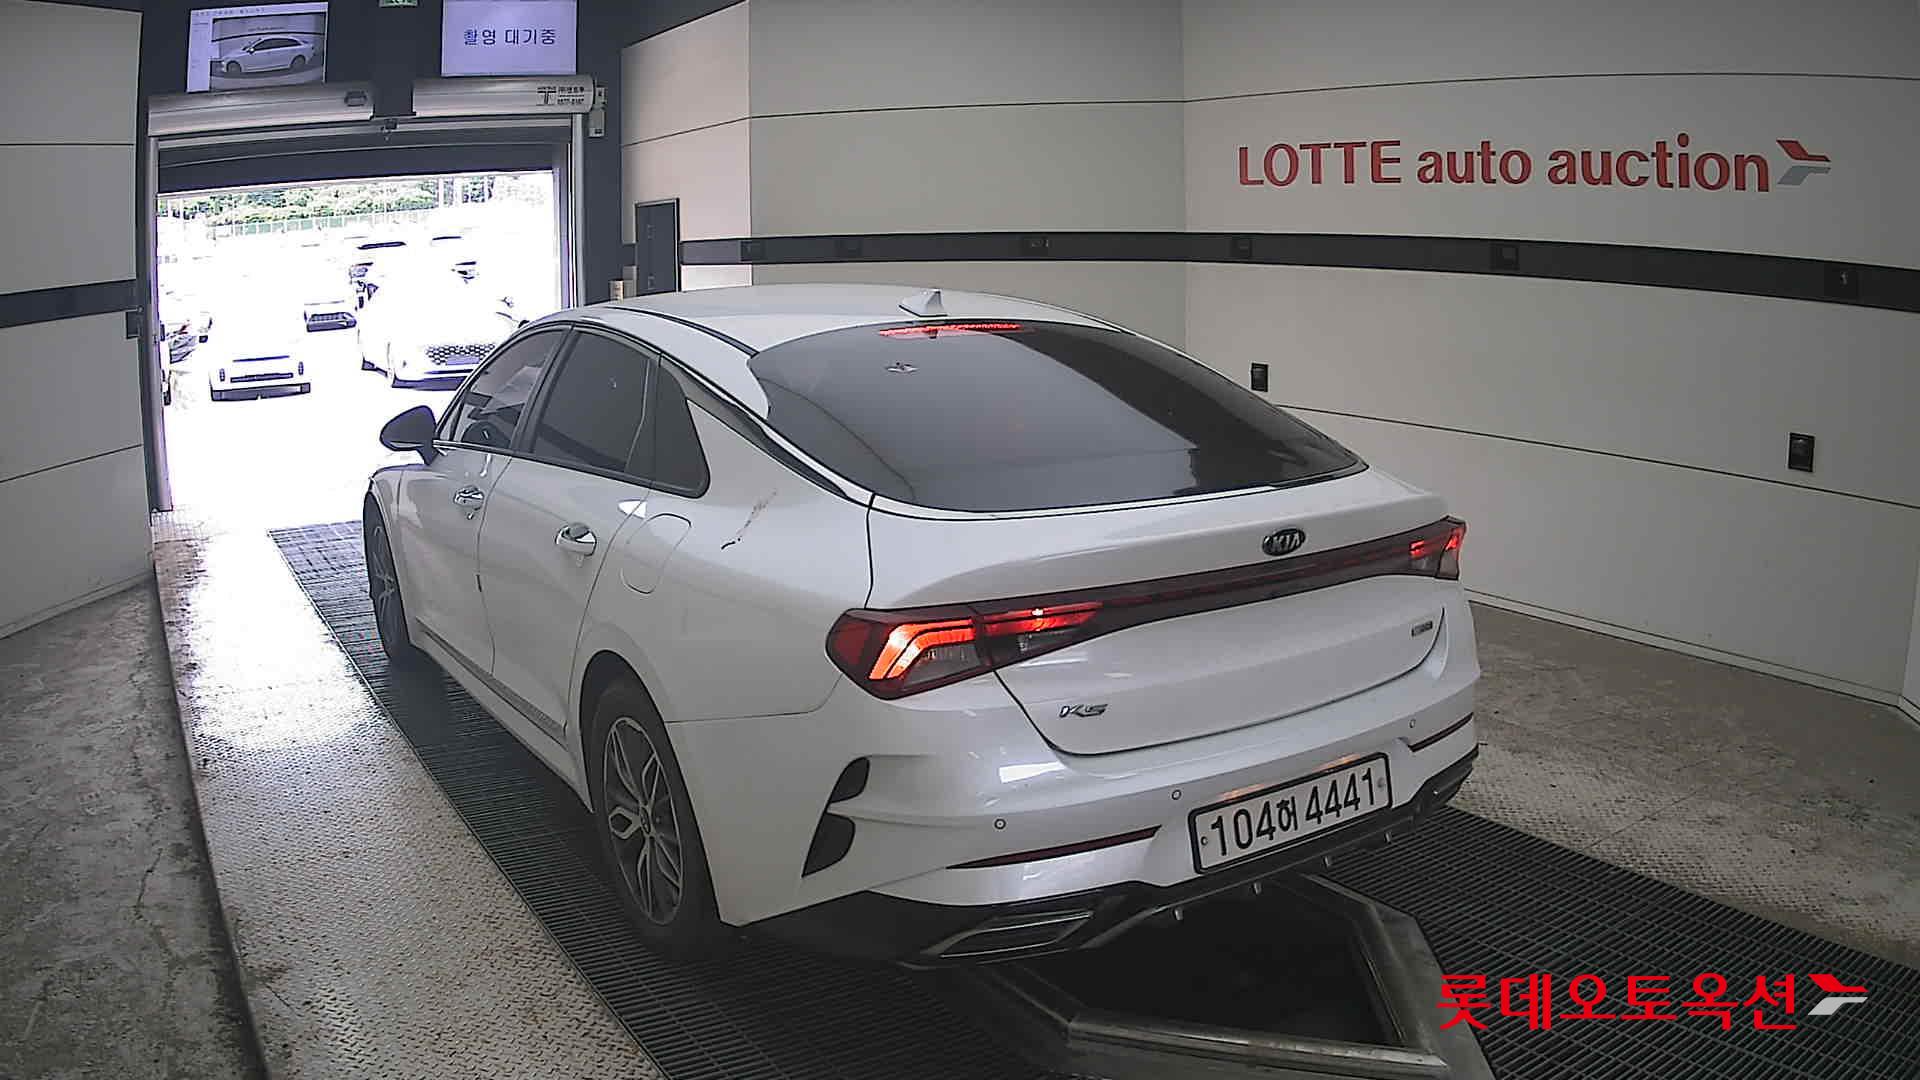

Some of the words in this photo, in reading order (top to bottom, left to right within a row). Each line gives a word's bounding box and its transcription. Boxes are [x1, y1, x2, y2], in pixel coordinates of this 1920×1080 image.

[464, 28, 496, 46] 촬영
[504, 28, 556, 46] 대기중
[1238, 140, 1402, 187] LOTTE
[1416, 140, 1534, 185] auto
[1547, 133, 1770, 192] auction
[1059, 703, 1108, 719] K5
[1304, 767, 1375, 825] 4441
